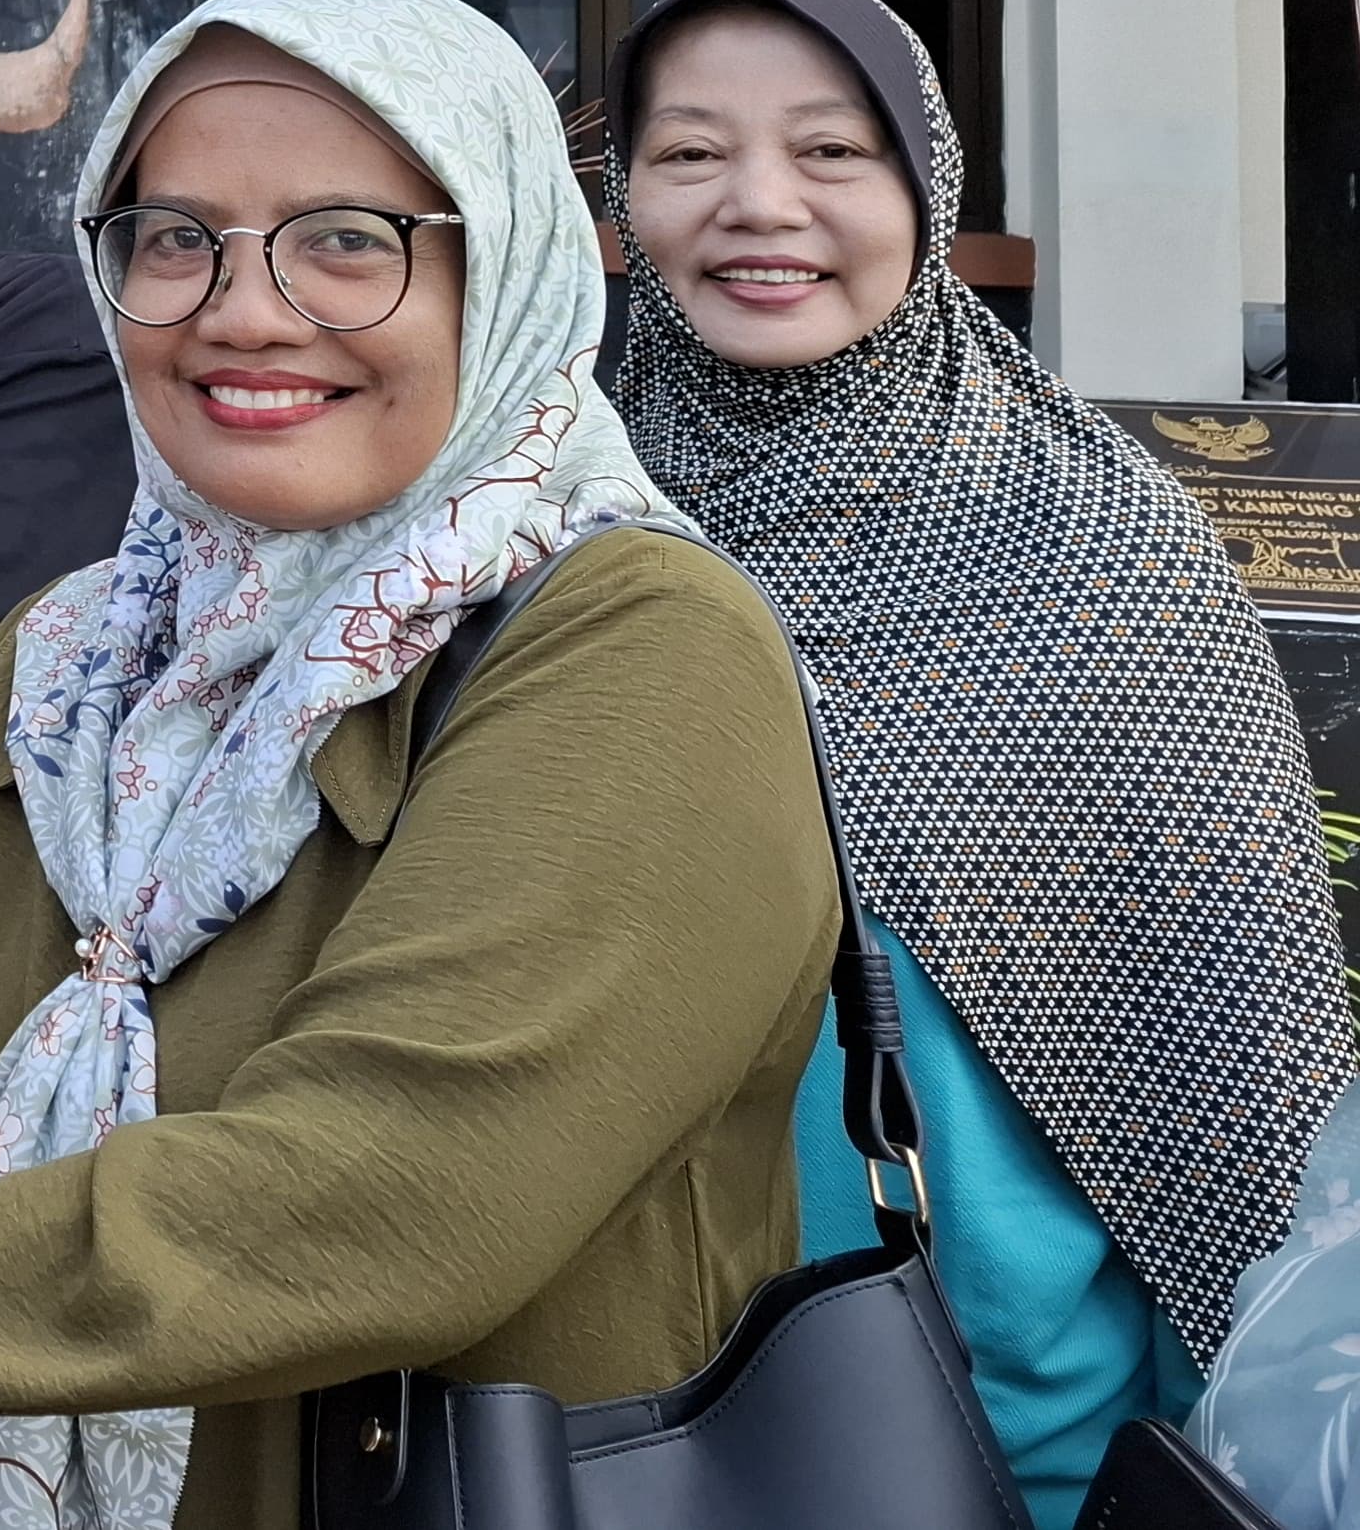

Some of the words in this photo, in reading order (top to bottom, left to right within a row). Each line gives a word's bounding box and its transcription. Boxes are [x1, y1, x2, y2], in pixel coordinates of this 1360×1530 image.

[1185, 486, 1219, 496] MAT
[1222, 488, 1284, 499] TUHAN
[1285, 490, 1336, 502] YANG
[1224, 500, 1354, 517] KAMPUNG
